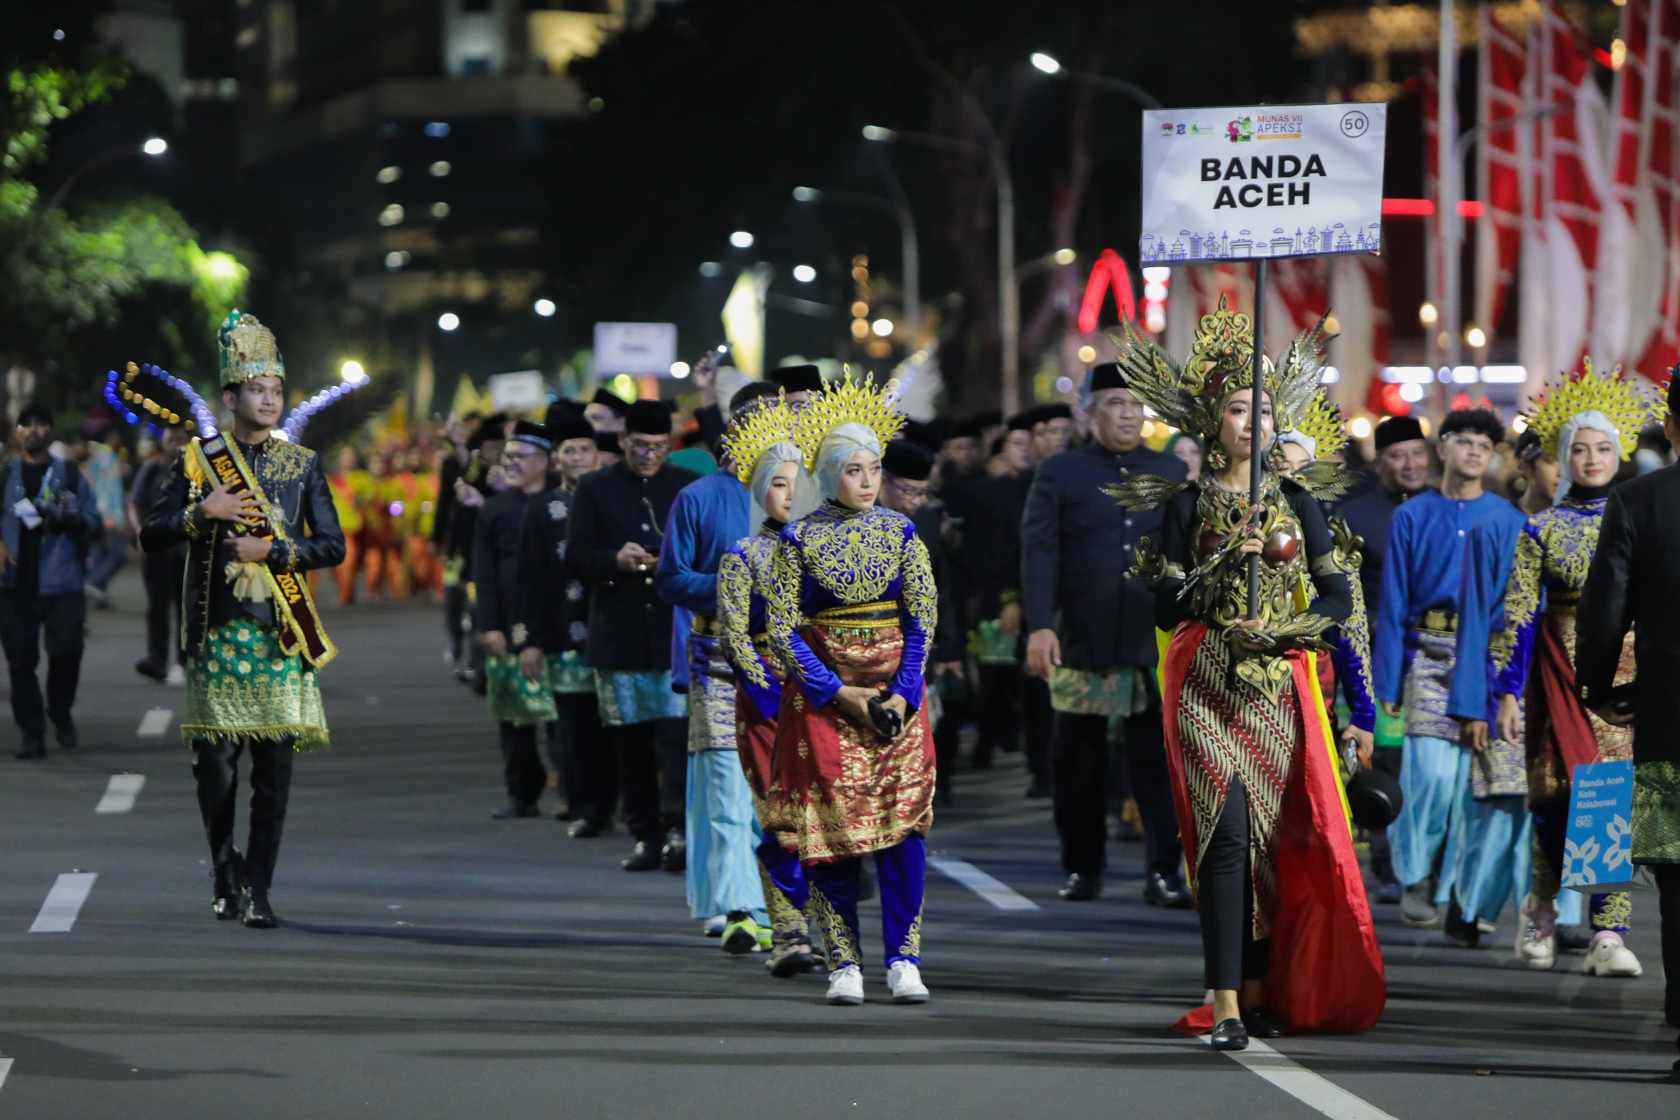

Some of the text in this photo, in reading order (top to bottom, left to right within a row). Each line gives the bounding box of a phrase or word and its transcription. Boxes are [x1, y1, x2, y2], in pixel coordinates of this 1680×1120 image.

[1257, 114, 1303, 123] MUNAS VII
[1257, 122, 1303, 133] APEKSI
[1344, 117, 1364, 130] 50
[1201, 154, 1327, 182] BANDA
[1213, 182, 1310, 209] ACEH
[276, 572, 302, 604] 2024
